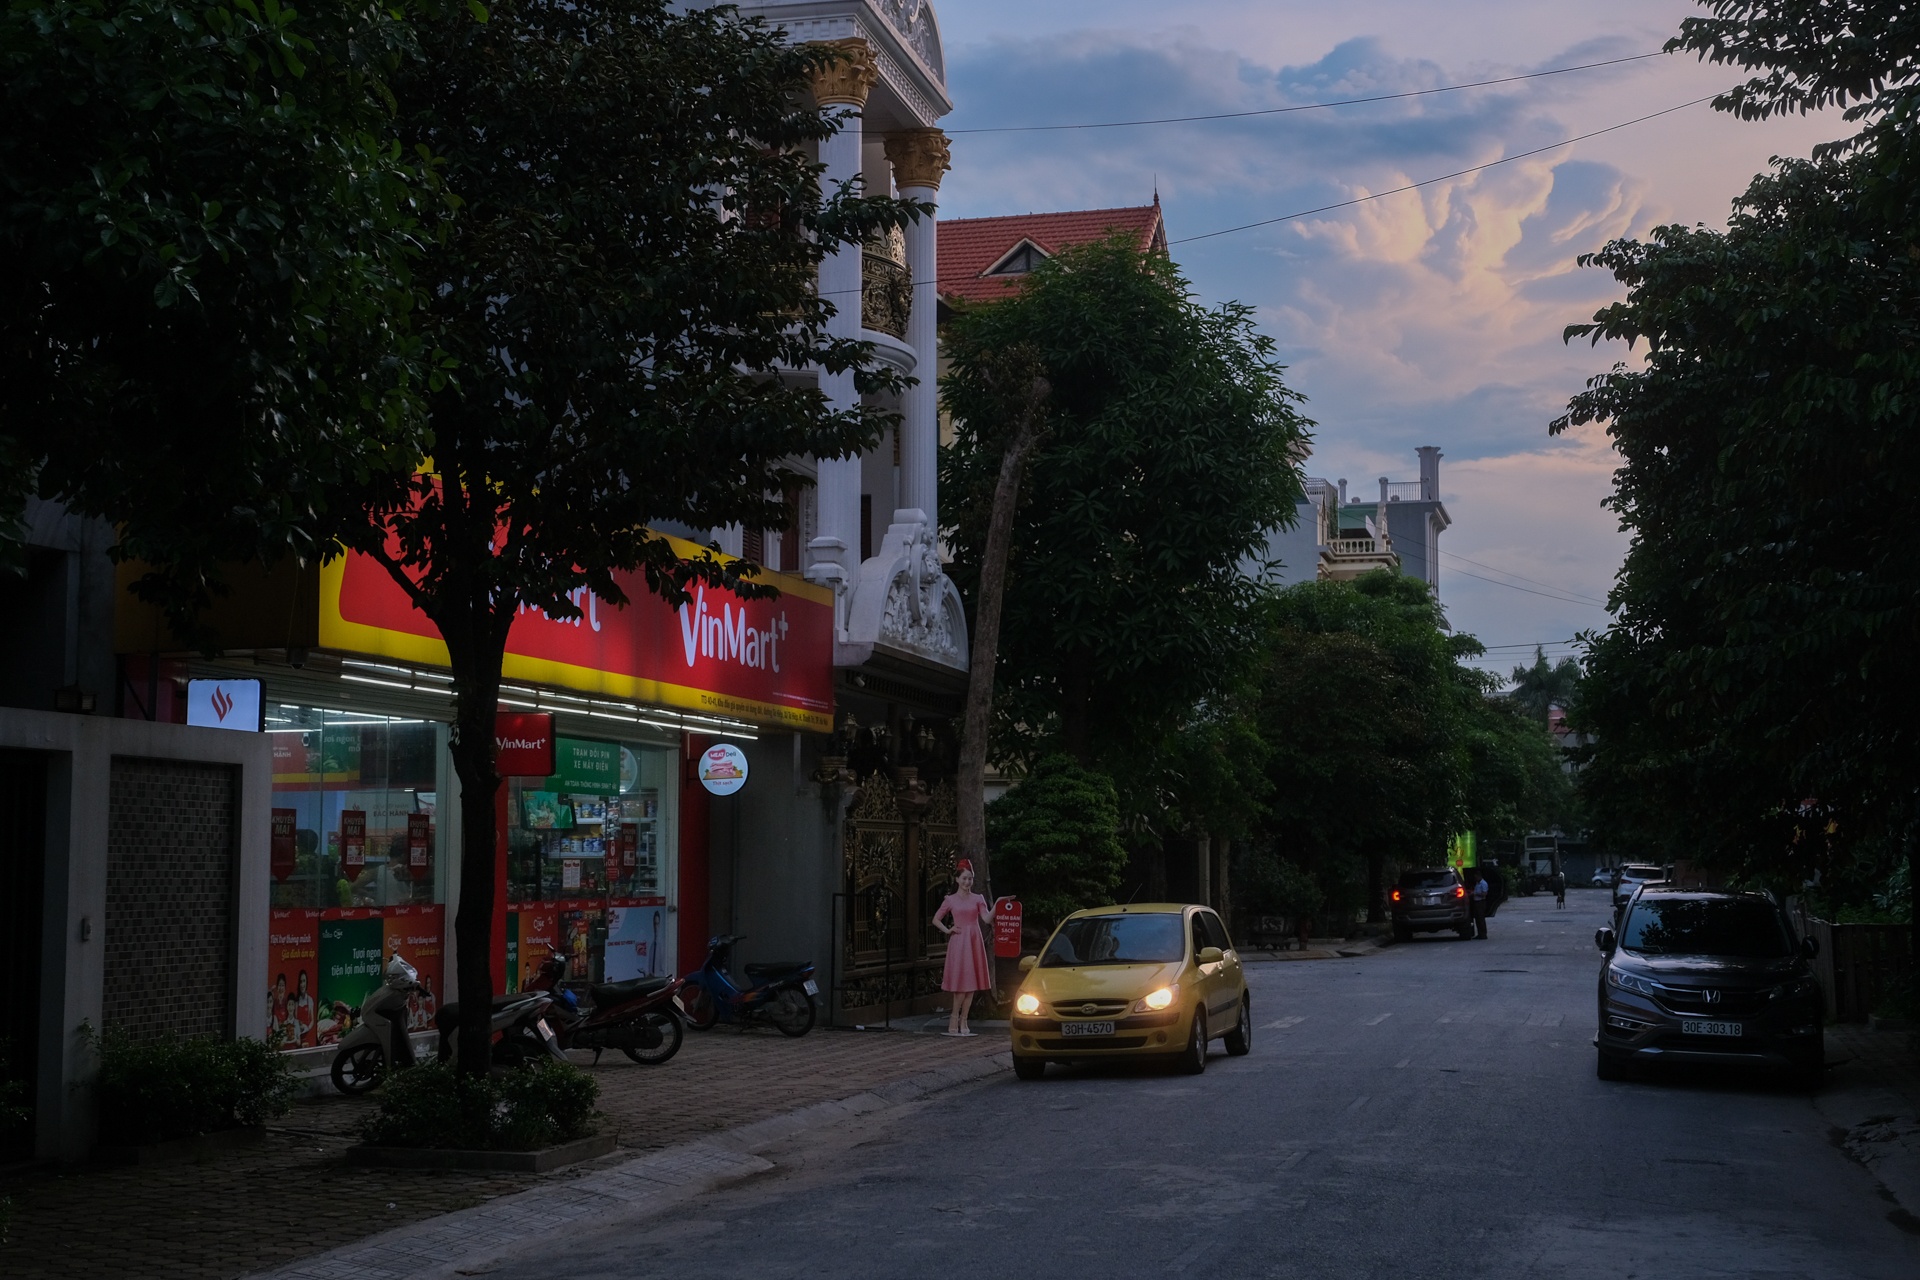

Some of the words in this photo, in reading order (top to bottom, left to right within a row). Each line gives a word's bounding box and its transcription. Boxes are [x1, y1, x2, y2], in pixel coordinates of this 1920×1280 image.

[680, 584, 788, 674] VinMart+
[1065, 1023, 1112, 1035] 30H-4570
[1684, 1022, 1740, 1035] 30E-303.18
